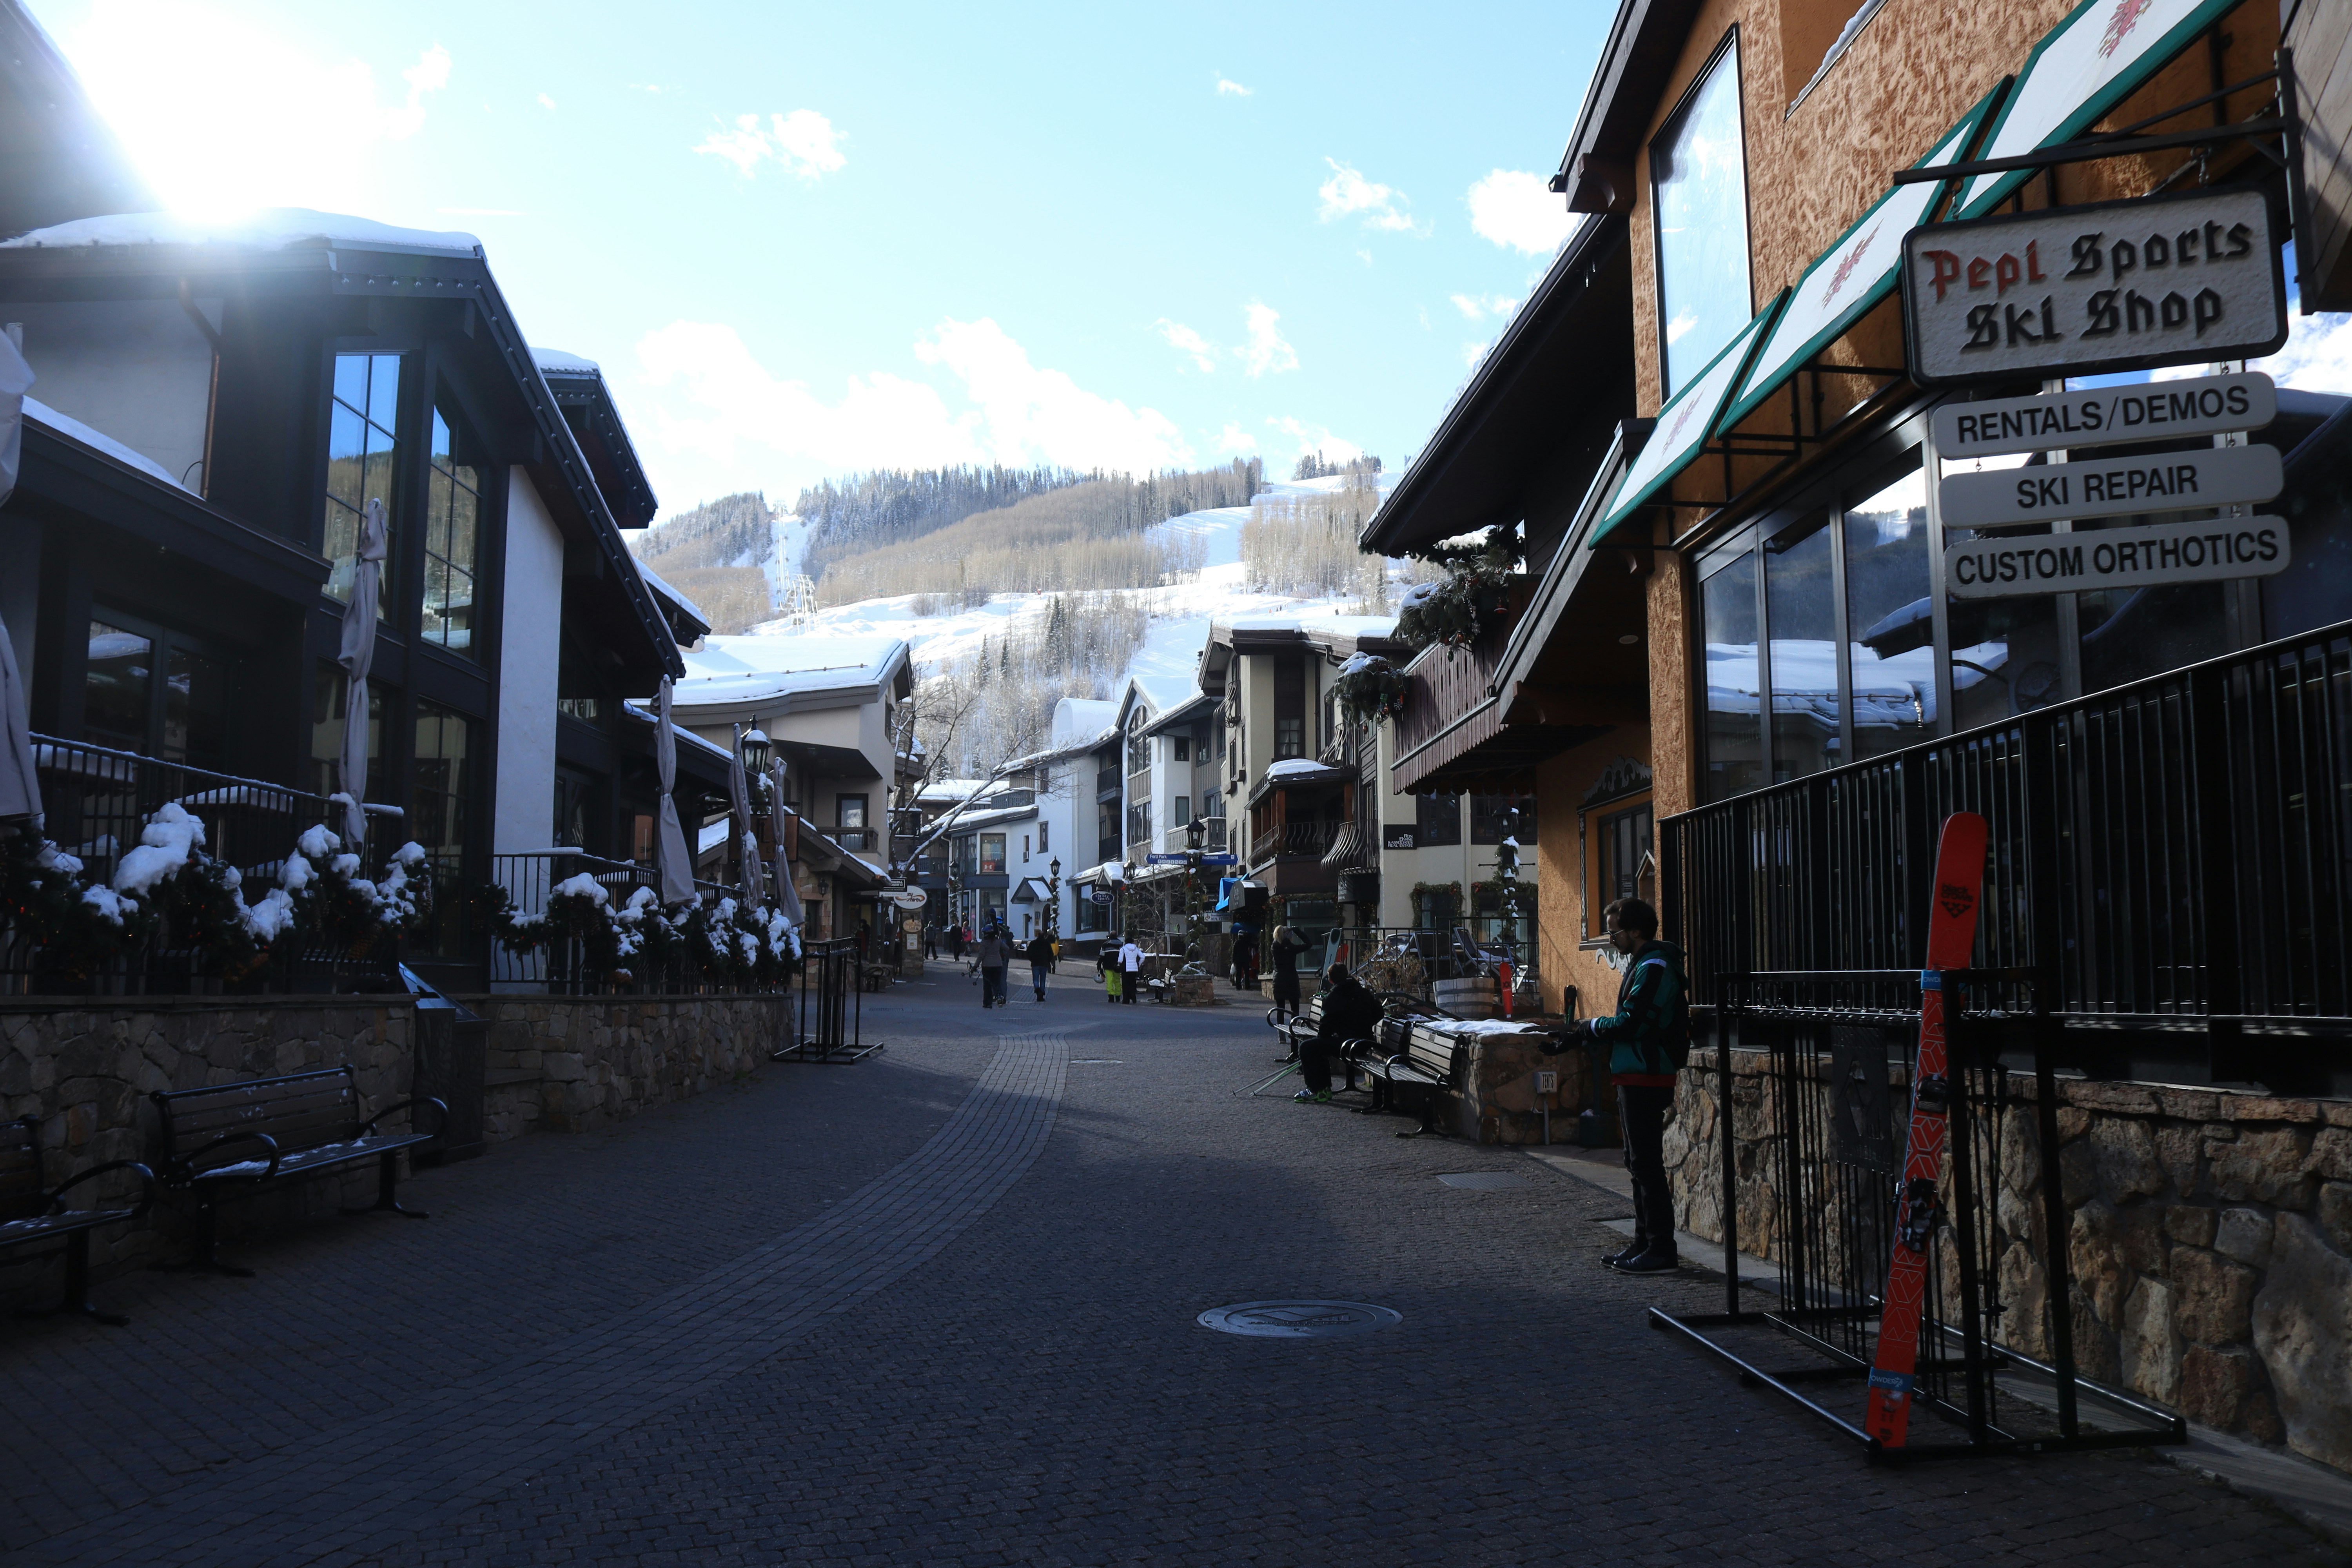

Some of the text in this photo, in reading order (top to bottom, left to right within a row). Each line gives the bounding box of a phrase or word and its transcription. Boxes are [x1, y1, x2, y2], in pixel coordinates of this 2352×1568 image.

[1922, 220, 2250, 300] Pepi Sports
[1960, 286, 2223, 351] Ski Shop
[1958, 385, 2249, 443] RENTALS/DEMOS
[2017, 465, 2200, 509] SKI REPAIR
[1956, 530, 2279, 585] CUSTOM ORTHOTICS
[1941, 892, 1973, 902] crows
[1942, 884, 1969, 894] black
[1542, 1073, 1553, 1089] TENTS
